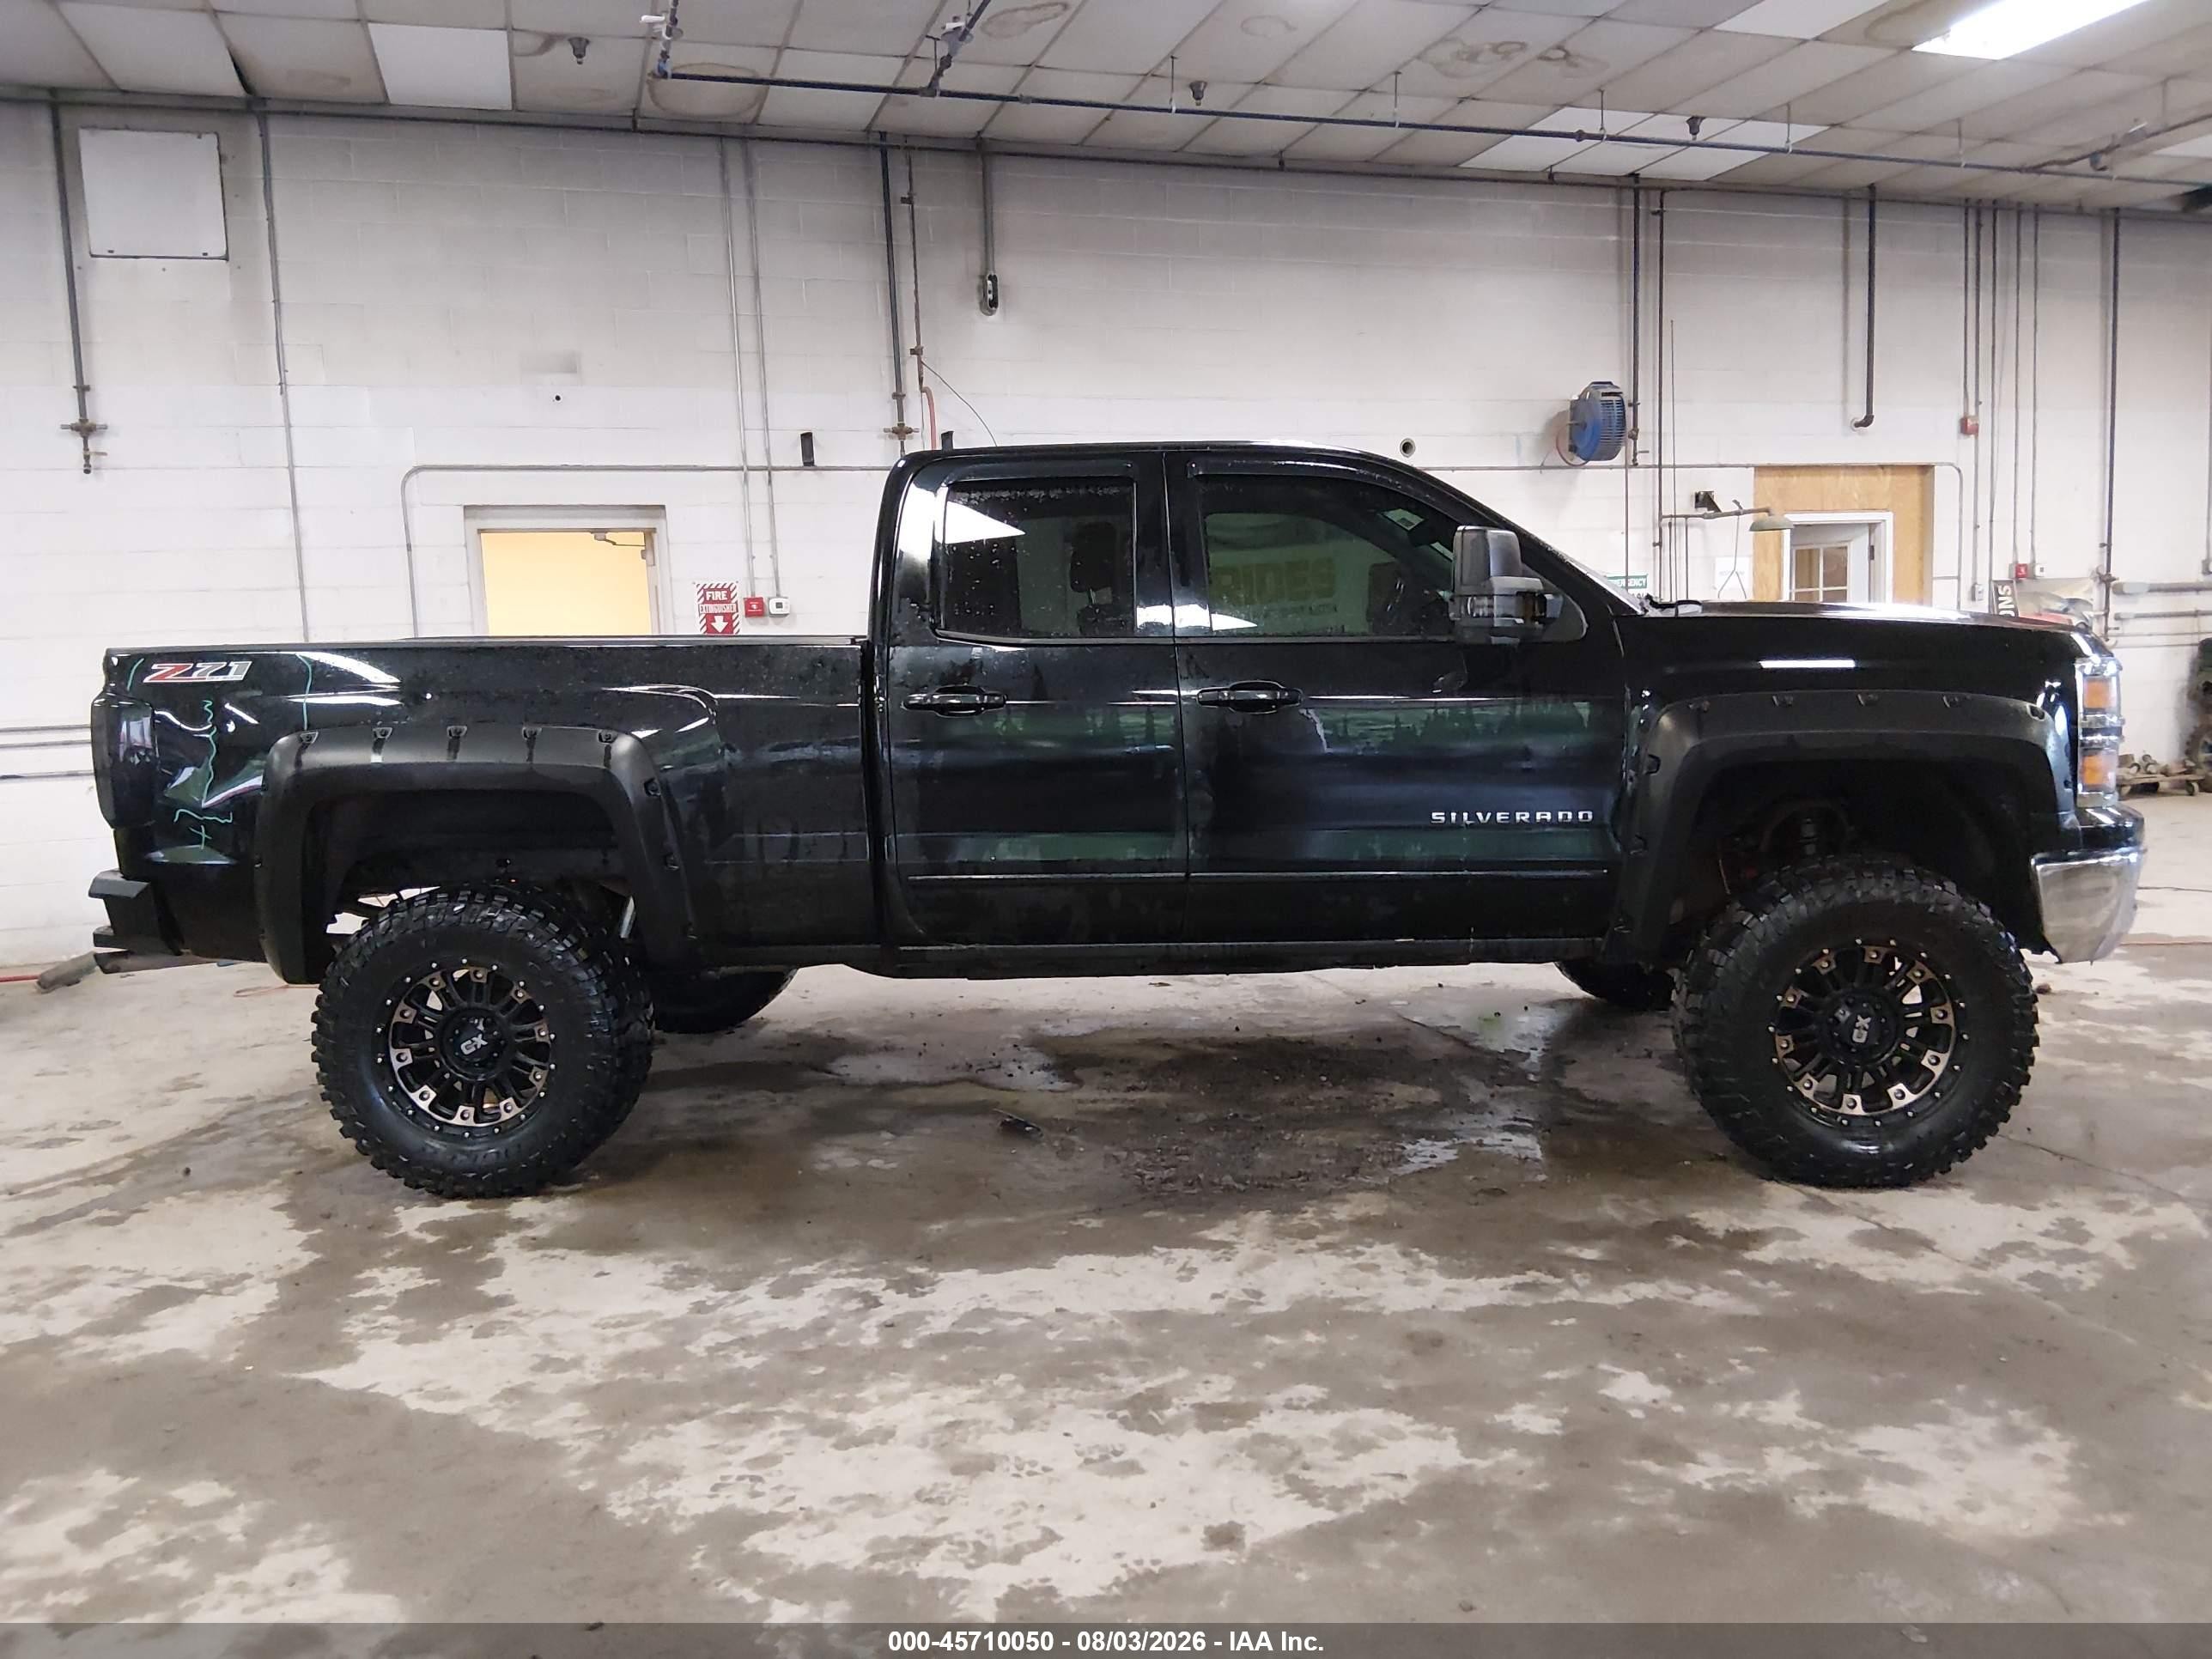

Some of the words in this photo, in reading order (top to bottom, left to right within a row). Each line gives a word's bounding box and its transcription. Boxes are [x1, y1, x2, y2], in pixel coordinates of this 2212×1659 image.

[706, 591, 727, 600] FIRE
[699, 604, 737, 614] EXTINGUISHER
[143, 661, 252, 683] Z71
[1431, 811, 1594, 823] SILVERADO
